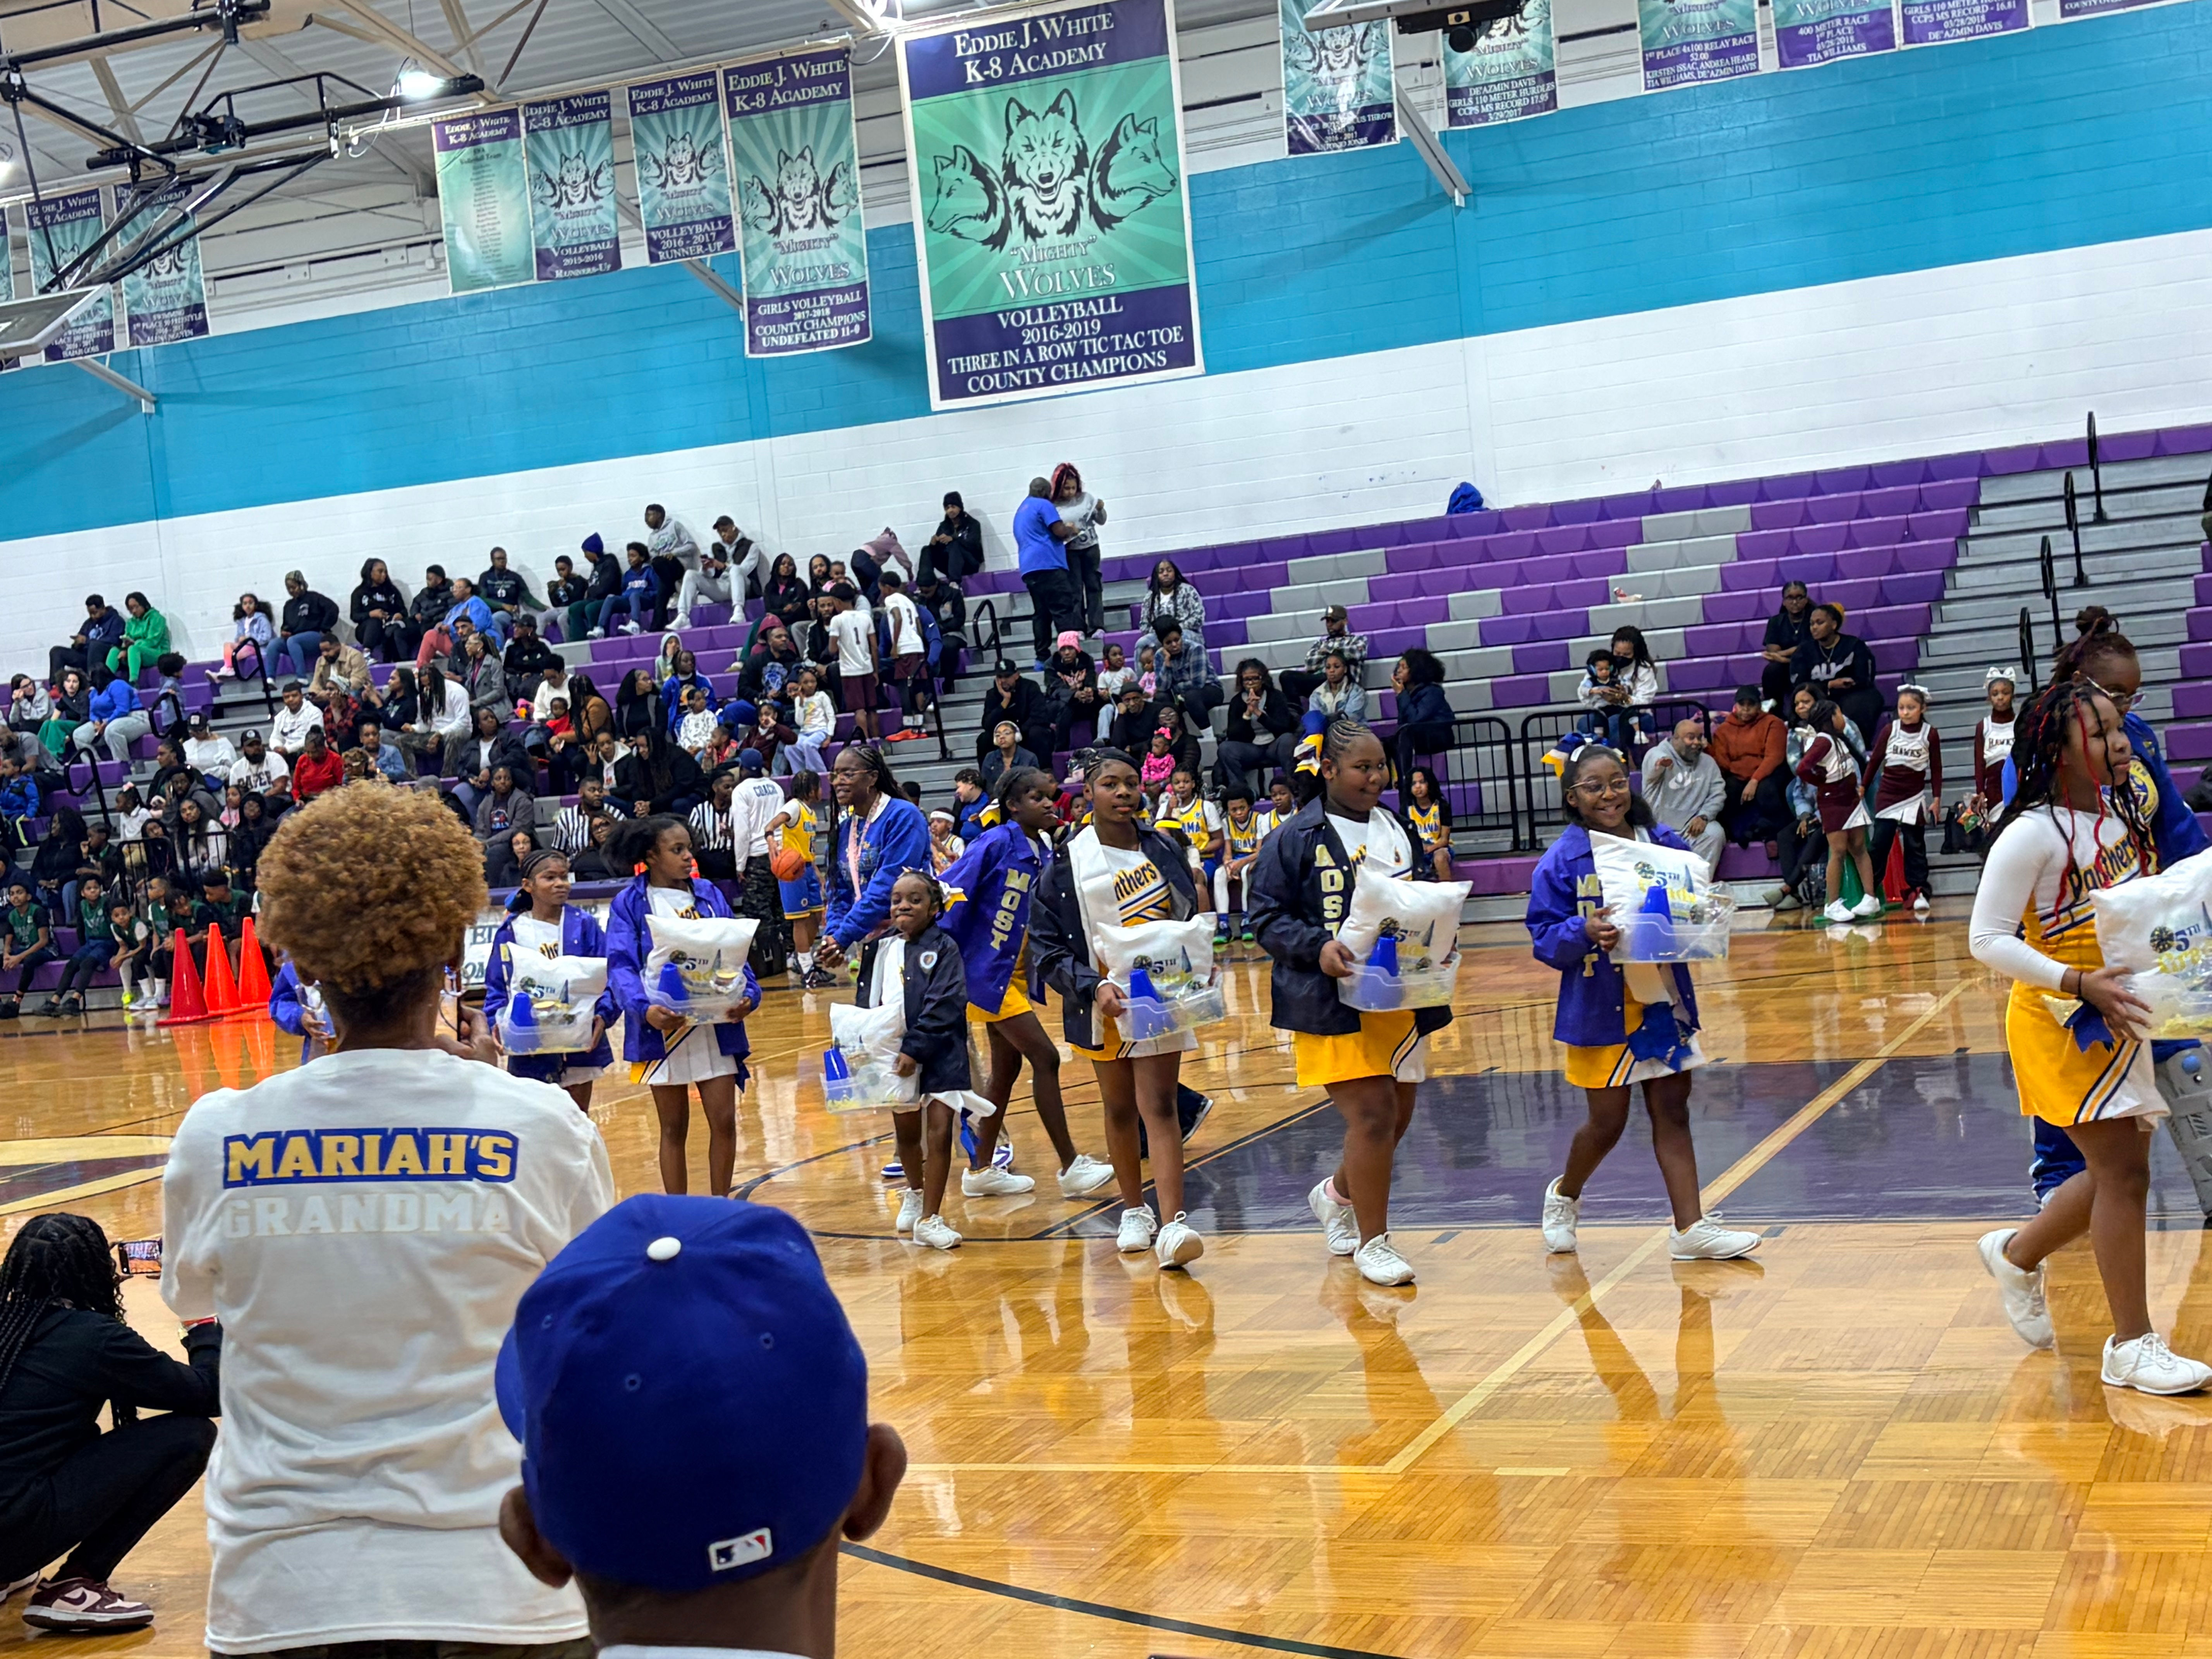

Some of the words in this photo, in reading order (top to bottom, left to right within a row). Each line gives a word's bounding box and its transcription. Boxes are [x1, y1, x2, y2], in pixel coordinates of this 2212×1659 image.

[1904, 6, 1931, 15] GIRLS
[1936, 10, 1950, 21] MS
[1951, 5, 1989, 18] RECORD
[954, 31, 1018, 58] EDDIE
[1020, 22, 1038, 49] J.
[1037, 13, 1114, 40] WHITE
[1662, 19, 1736, 40] WOLVES
[1798, 26, 1814, 36] 400
[1815, 18, 1842, 34] METER
[1844, 14, 1870, 26] RACE
[1826, 26, 1854, 38] PLACE
[1976, 21, 2003, 33] DAVIS
[1656, 46, 1681, 60] PLACE
[1704, 39, 1731, 52] RELAY
[1732, 34, 1755, 47] RACE
[1806, 53, 1822, 62] TIA
[1823, 42, 1867, 59] WILLIAMS
[964, 56, 1003, 84] K-8
[1009, 42, 1106, 76] ACADEMY
[1466, 58, 1539, 79] WOLVES
[1730, 53, 1757, 65] HEARD
[728, 72, 774, 92] EDDIE
[790, 59, 847, 80] WHITE
[1511, 77, 1536, 88] DAVIS
[631, 87, 665, 101] EDDIE
[678, 78, 716, 91] WHITE
[734, 92, 766, 112] K-8
[769, 82, 843, 106] ACADEMY
[1449, 98, 1473, 108] GIRLS
[1475, 95, 1489, 105] 110
[1489, 90, 1518, 101] METER
[1519, 81, 1555, 96] HURDLES
[572, 95, 610, 109] WHITE
[636, 100, 659, 113] K-8
[662, 91, 713, 109] ACADEMY
[1481, 103, 1494, 113] MS
[1495, 97, 1529, 109] RECORD
[445, 122, 471, 134] EDDIE
[481, 116, 511, 128] WHITE
[528, 117, 551, 131] K-8
[555, 109, 608, 126] ACADEMY
[1367, 112, 1393, 122] THROW
[449, 132, 467, 145] K-8
[469, 127, 508, 140] ACADEMY
[67, 194, 99, 207] WHITE
[656, 202, 716, 220] WOLVES
[53, 206, 97, 223] ACADEMY
[551, 224, 612, 240] WOLVES
[651, 220, 726, 241] VOLLEYBALL
[660, 237, 684, 250] 2016
[692, 232, 717, 245] 2017
[552, 241, 614, 258] VOLLEYBALL
[659, 241, 724, 261] RUNNER-UP
[770, 262, 851, 288] WOLVES
[998, 263, 1116, 299] WOLVES
[757, 301, 791, 316] GIRLS
[792, 290, 864, 310] VOLLEYBALL
[998, 296, 1123, 329] VOLLEYBALL
[756, 321, 801, 336] COUNTY
[804, 311, 867, 331] CHAMPIONS
[793, 307, 831, 321] 2017-2018
[762, 328, 839, 347] UNDEFEATED
[841, 324, 861, 338] 11-0
[1022, 318, 1101, 345] 2016-2019
[948, 352, 1001, 375] THREE
[1004, 348, 1020, 367] IN
[1024, 347, 1035, 364] A
[1039, 340, 1077, 362] ROW
[1079, 335, 1109, 355] TIC
[1110, 331, 1145, 351] TAC
[1147, 325, 1184, 345] TOE
[967, 367, 1046, 393] COUNTY
[1051, 350, 1167, 381] CHAMPIONS
[990, 867, 1032, 951] MOST
[225, 1130, 516, 1184] MARIAH'S
[221, 1192, 512, 1238] GRANDMA
